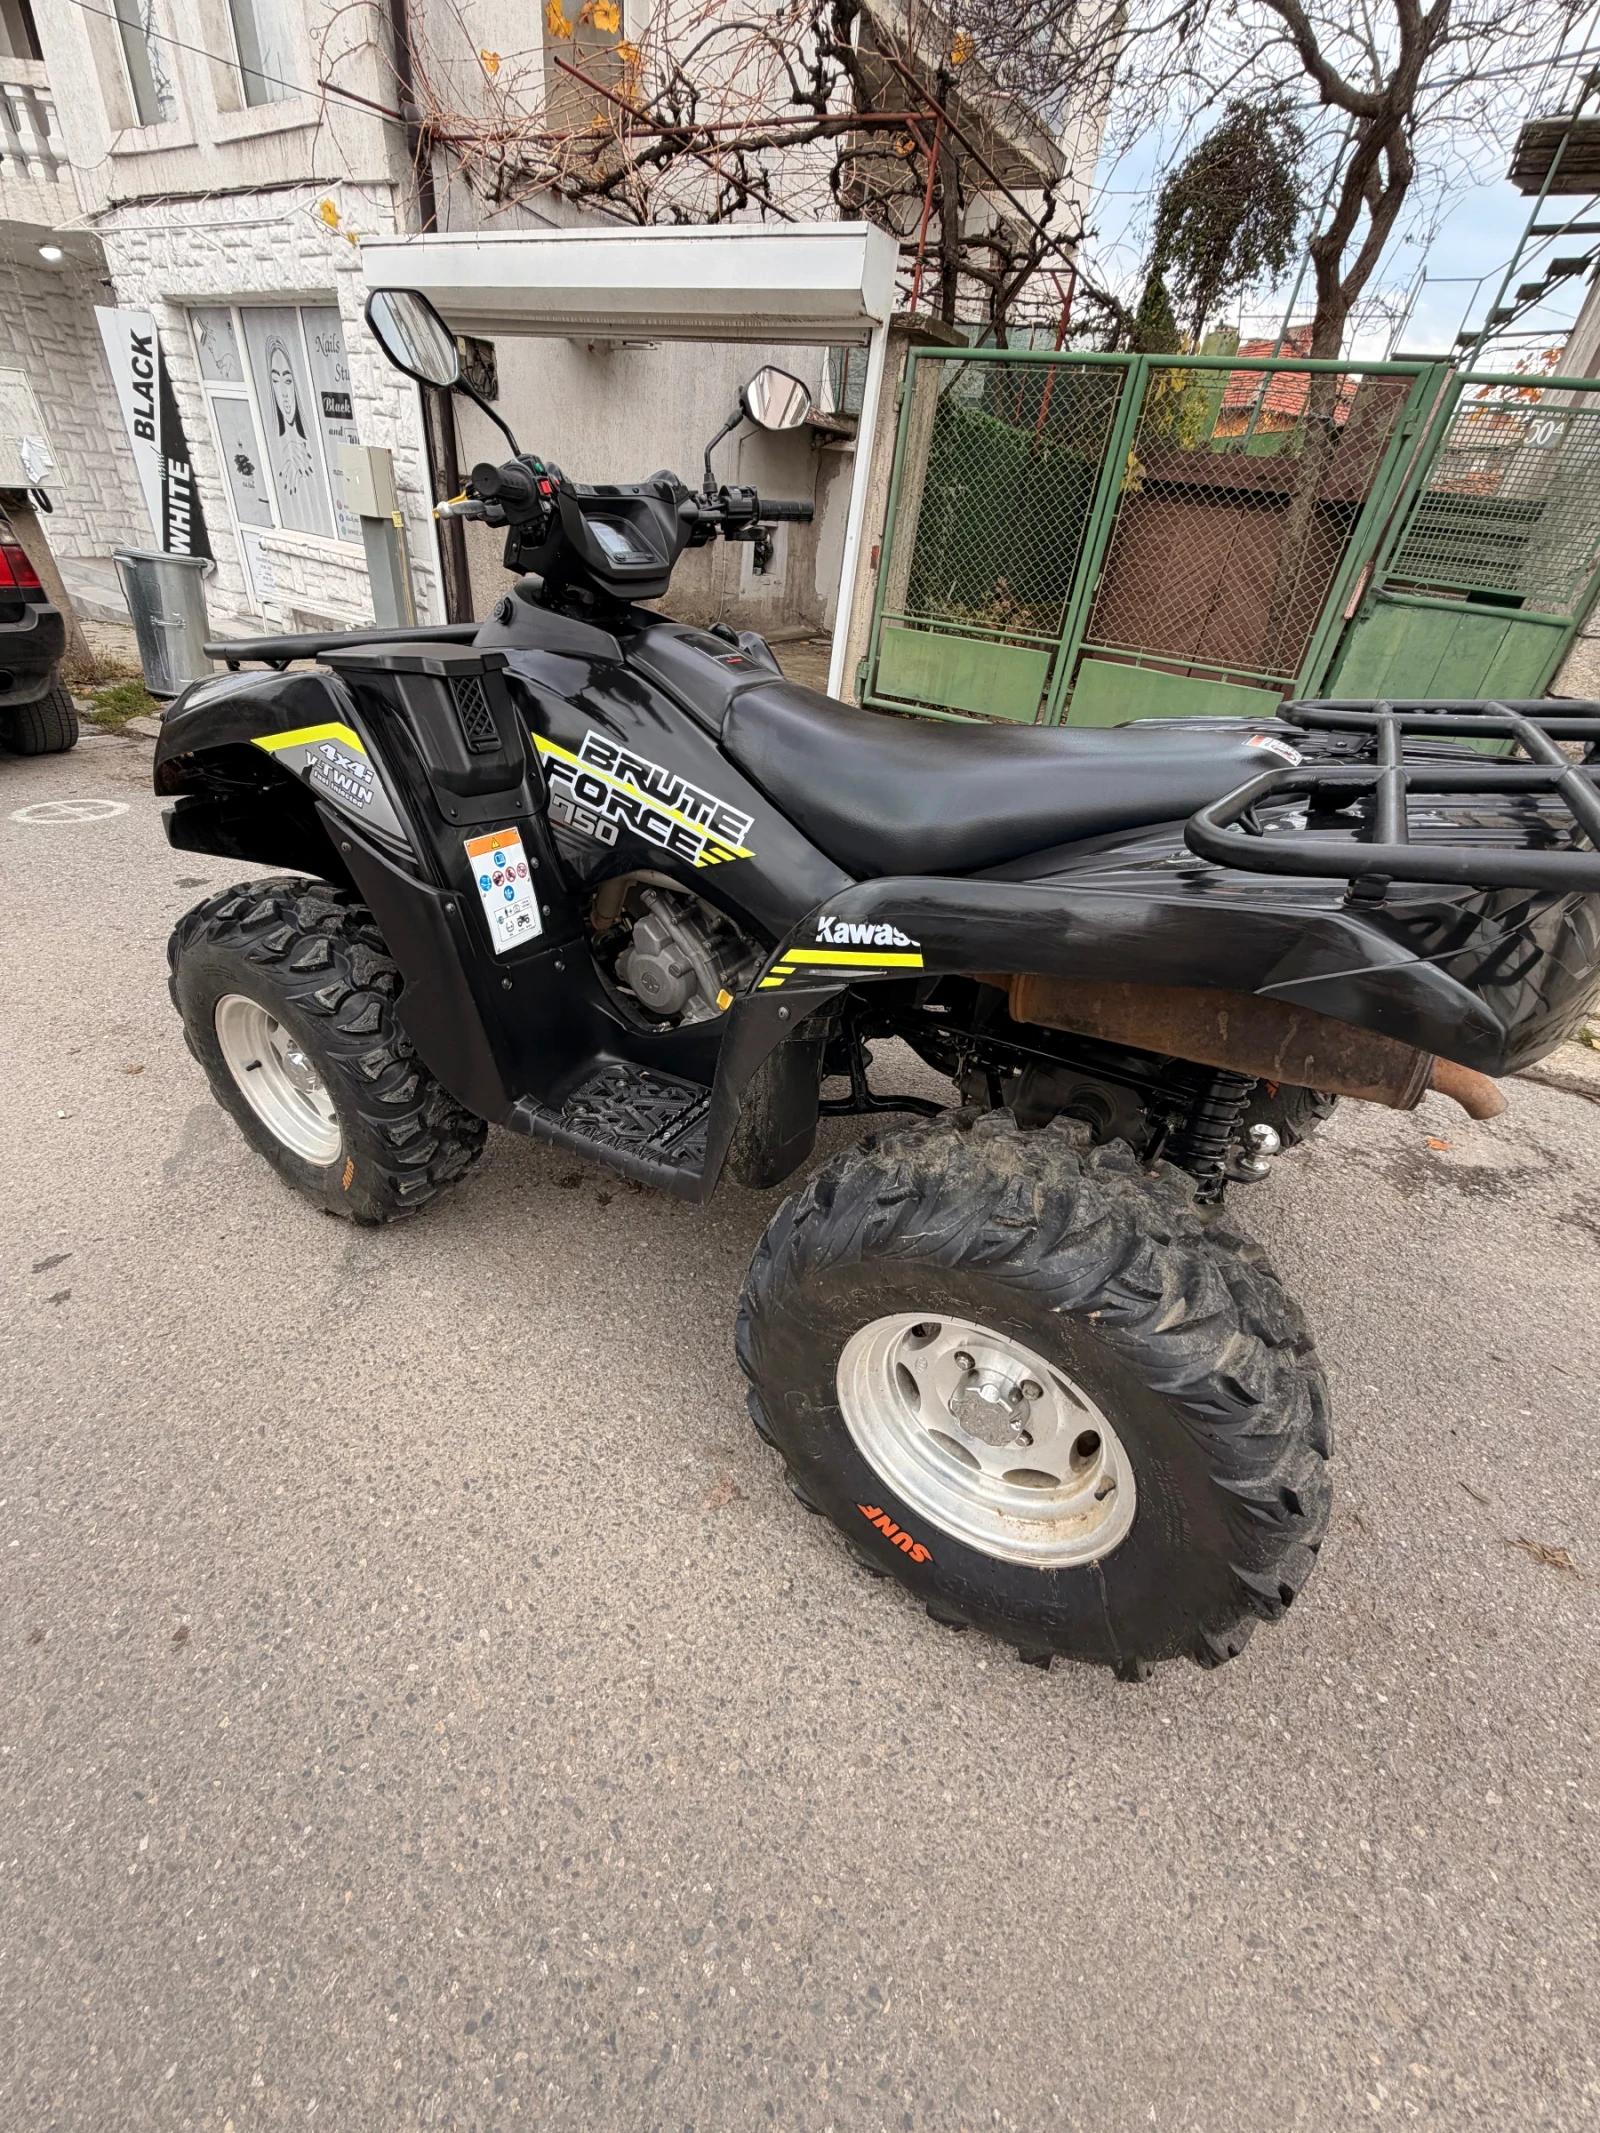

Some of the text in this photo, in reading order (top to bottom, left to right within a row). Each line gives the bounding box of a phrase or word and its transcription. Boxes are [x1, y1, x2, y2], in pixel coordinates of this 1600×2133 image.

[315, 333, 340, 357] Nails
[130, 327, 155, 442] BLACK
[324, 396, 351, 413] Black
[328, 426, 343, 436] and
[1523, 419, 1565, 445] 50A
[168, 457, 191, 555] WHITE
[305, 749, 374, 805] V-TWIN
[576, 729, 755, 850] BRUTE
[543, 751, 708, 866] FORCE
[552, 793, 619, 847] 750
[815, 916, 921, 947] Kawas
[856, 1503, 933, 1563] SUNF
